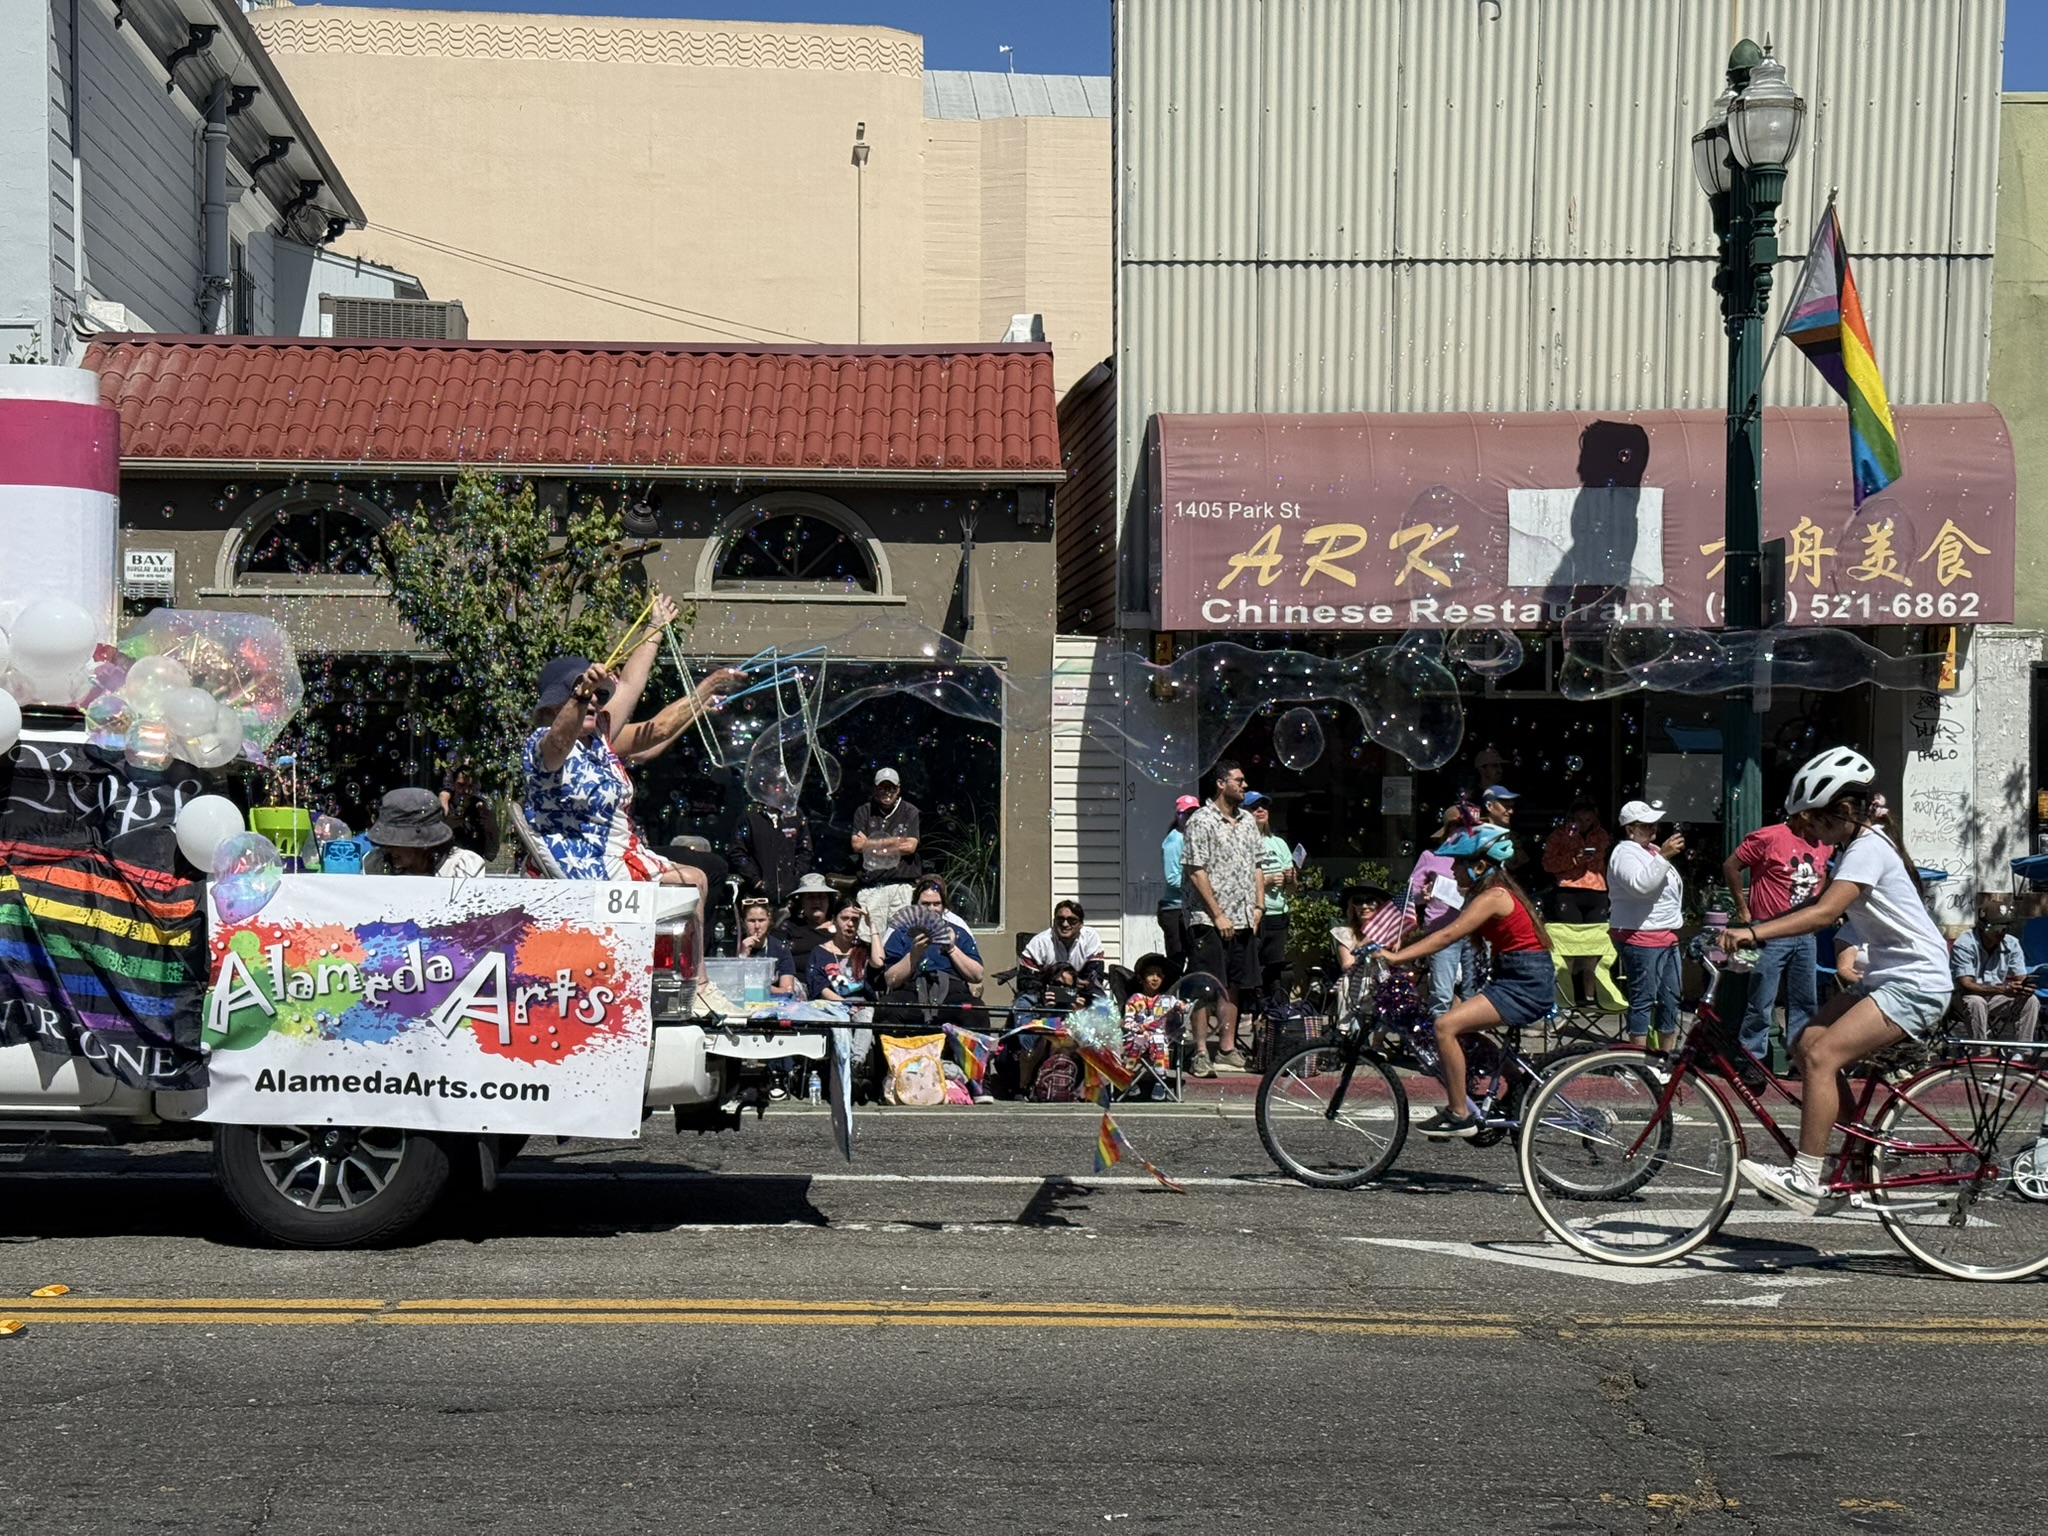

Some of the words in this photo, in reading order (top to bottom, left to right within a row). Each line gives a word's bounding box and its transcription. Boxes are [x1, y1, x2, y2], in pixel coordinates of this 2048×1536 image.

[1175, 502, 1223, 519] 1405
[1229, 502, 1274, 519] Park
[1279, 502, 1301, 519] St
[132, 555, 167, 565] BAY
[1217, 523, 1460, 590] ARK
[1201, 598, 1394, 624] Chinese
[1409, 597, 1675, 624] Restaurant
[1810, 592, 1980, 619] 521-6862
[607, 889, 641, 915] 84
[207, 939, 454, 1035] Alameda
[429, 951, 615, 1046] Arts
[254, 1068, 551, 1102] AlamedaArts.com
